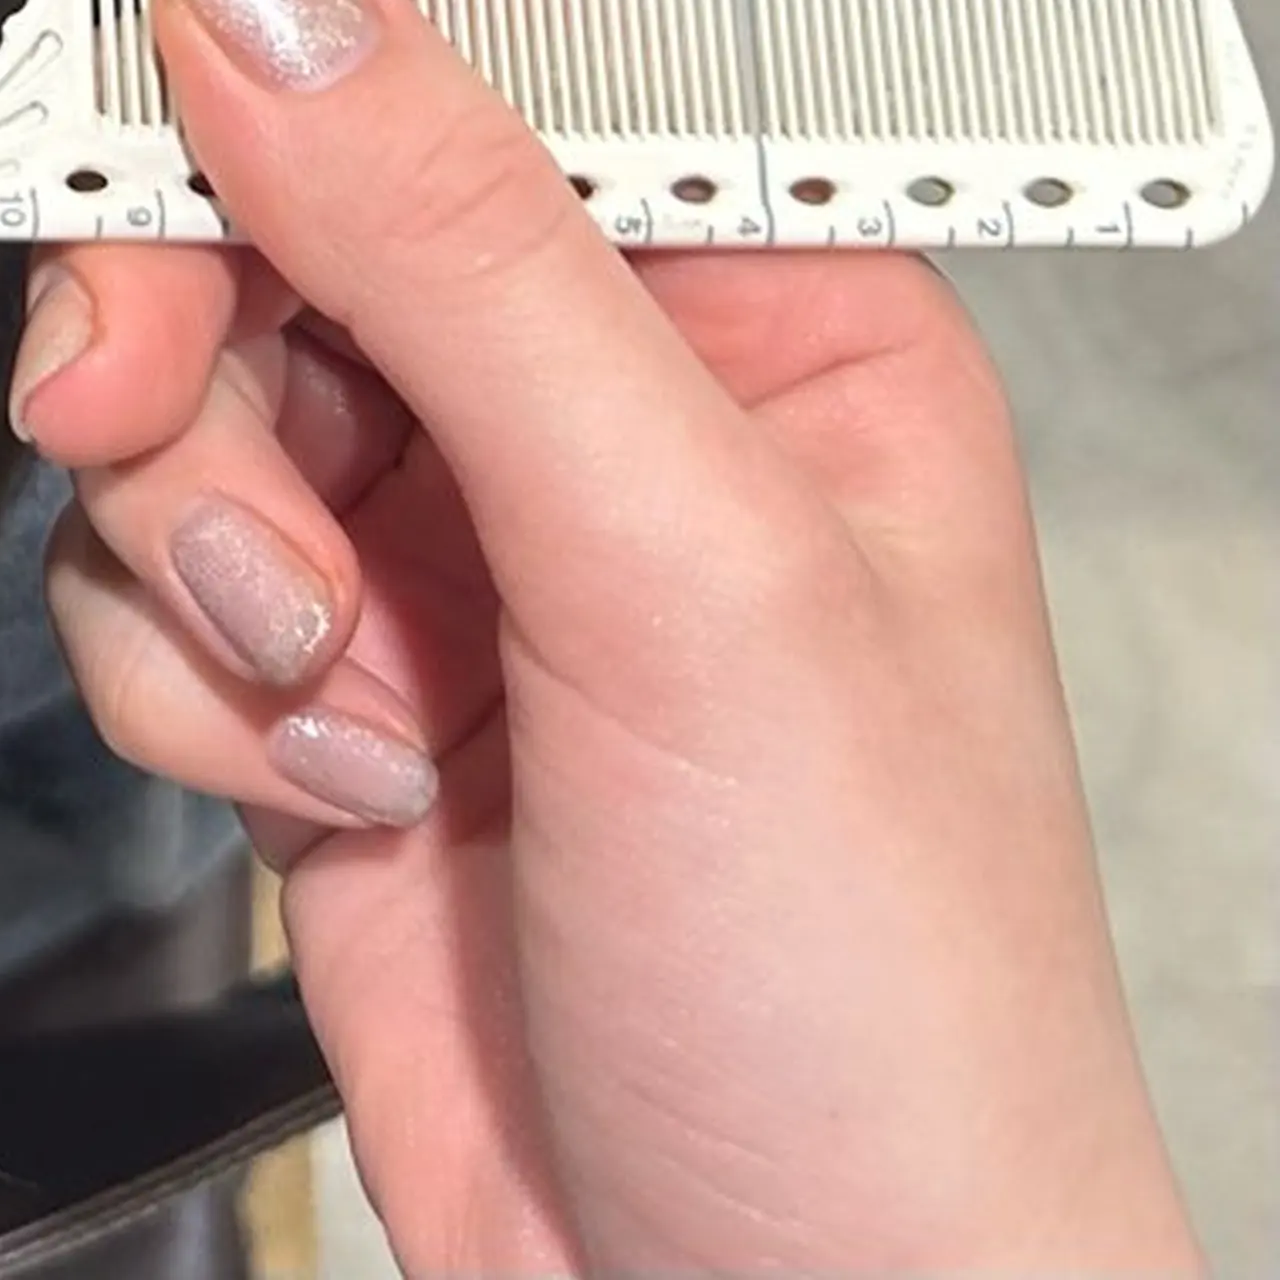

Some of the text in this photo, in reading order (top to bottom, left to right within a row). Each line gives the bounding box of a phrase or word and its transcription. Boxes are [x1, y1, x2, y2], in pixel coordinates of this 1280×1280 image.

[126, 206, 152, 226] 9
[614, 216, 643, 234] 5
[738, 216, 762, 235] 4
[857, 217, 882, 236] 3
[977, 219, 1002, 237] 2
[1097, 224, 1121, 234] 1
